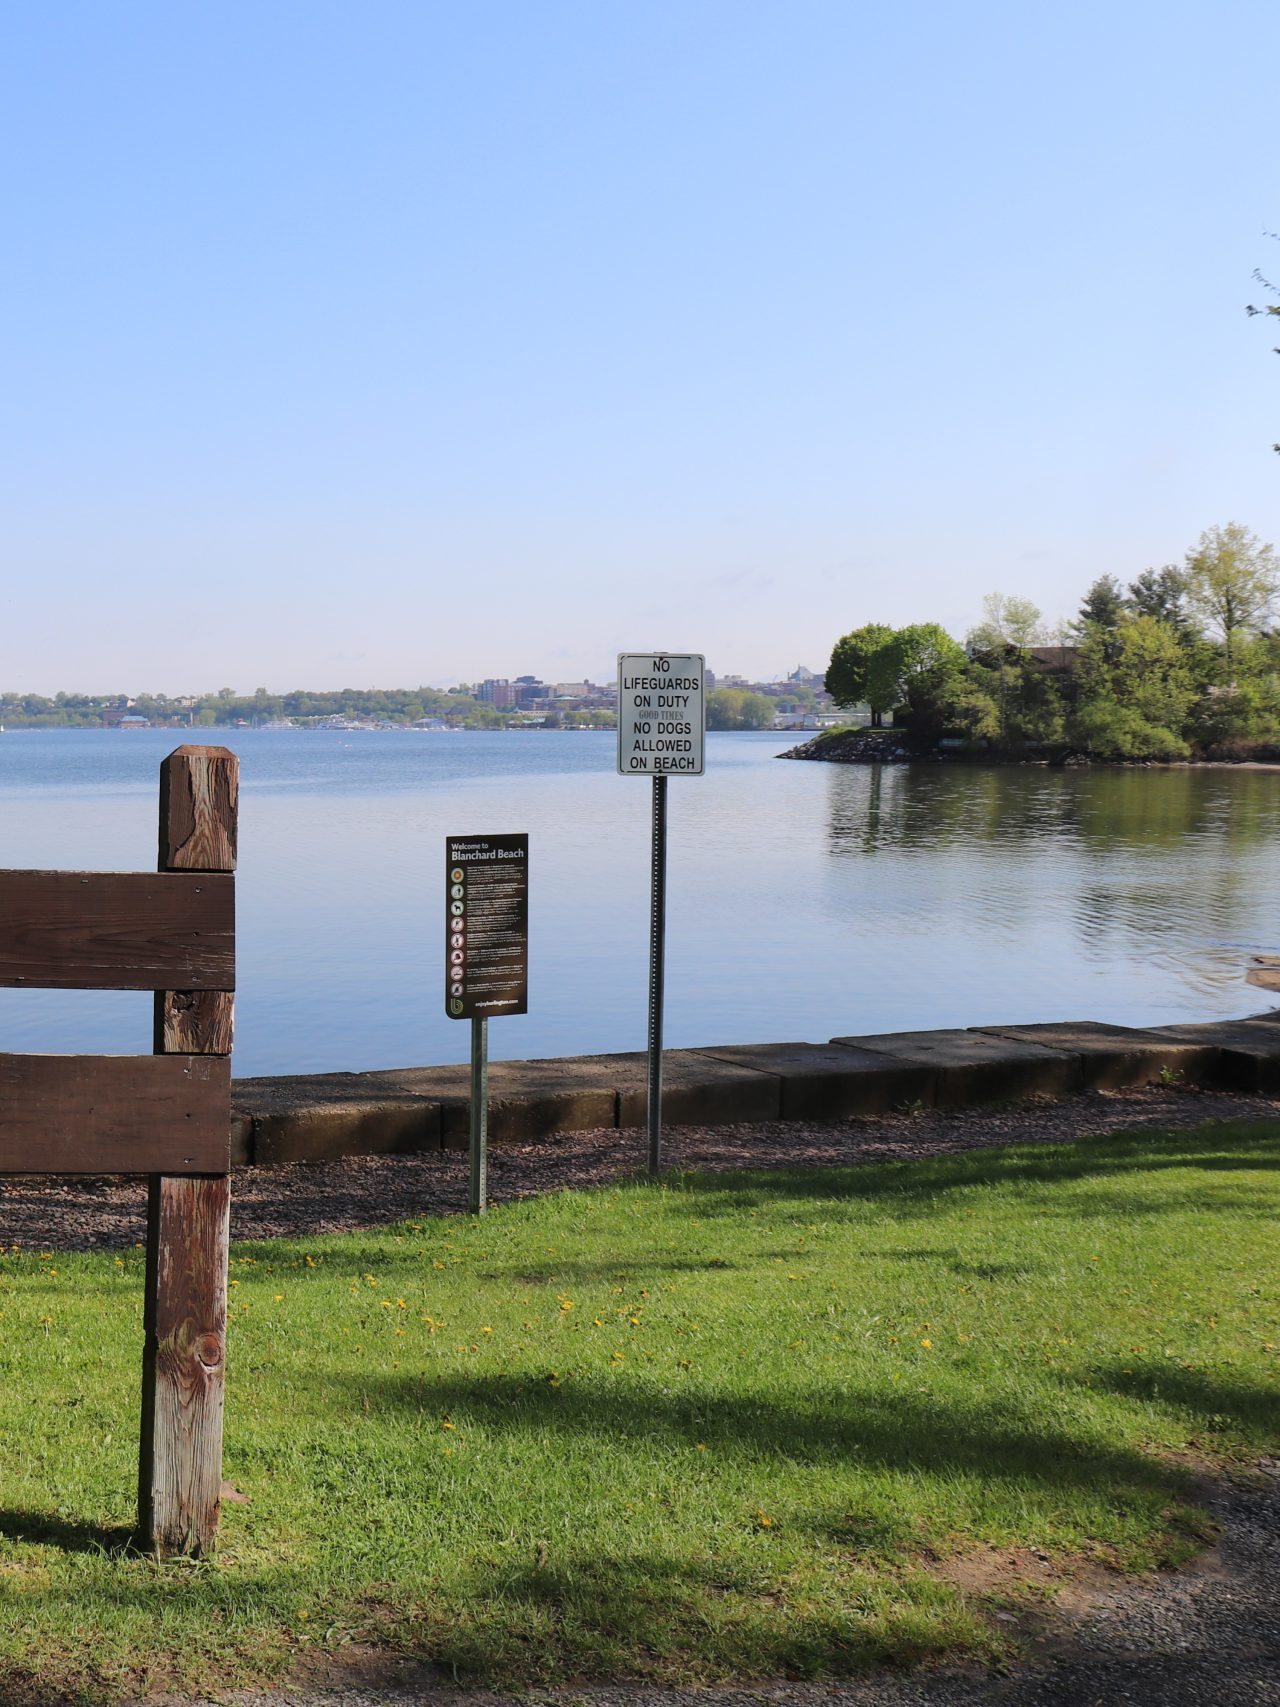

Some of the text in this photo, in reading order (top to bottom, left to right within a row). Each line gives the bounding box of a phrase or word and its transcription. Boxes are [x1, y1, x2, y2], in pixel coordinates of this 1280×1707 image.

[653, 660, 670, 672] NO
[624, 677, 699, 690] LIFEGUARDS
[633, 695, 689, 707] ON DUTY
[638, 709, 684, 720] GOOD TIMES
[633, 721, 691, 734] NO DOGS
[633, 739, 692, 752] ALLOWED
[630, 756, 695, 769] ON BEACH
[451, 848, 524, 861] Blanchard Beach
